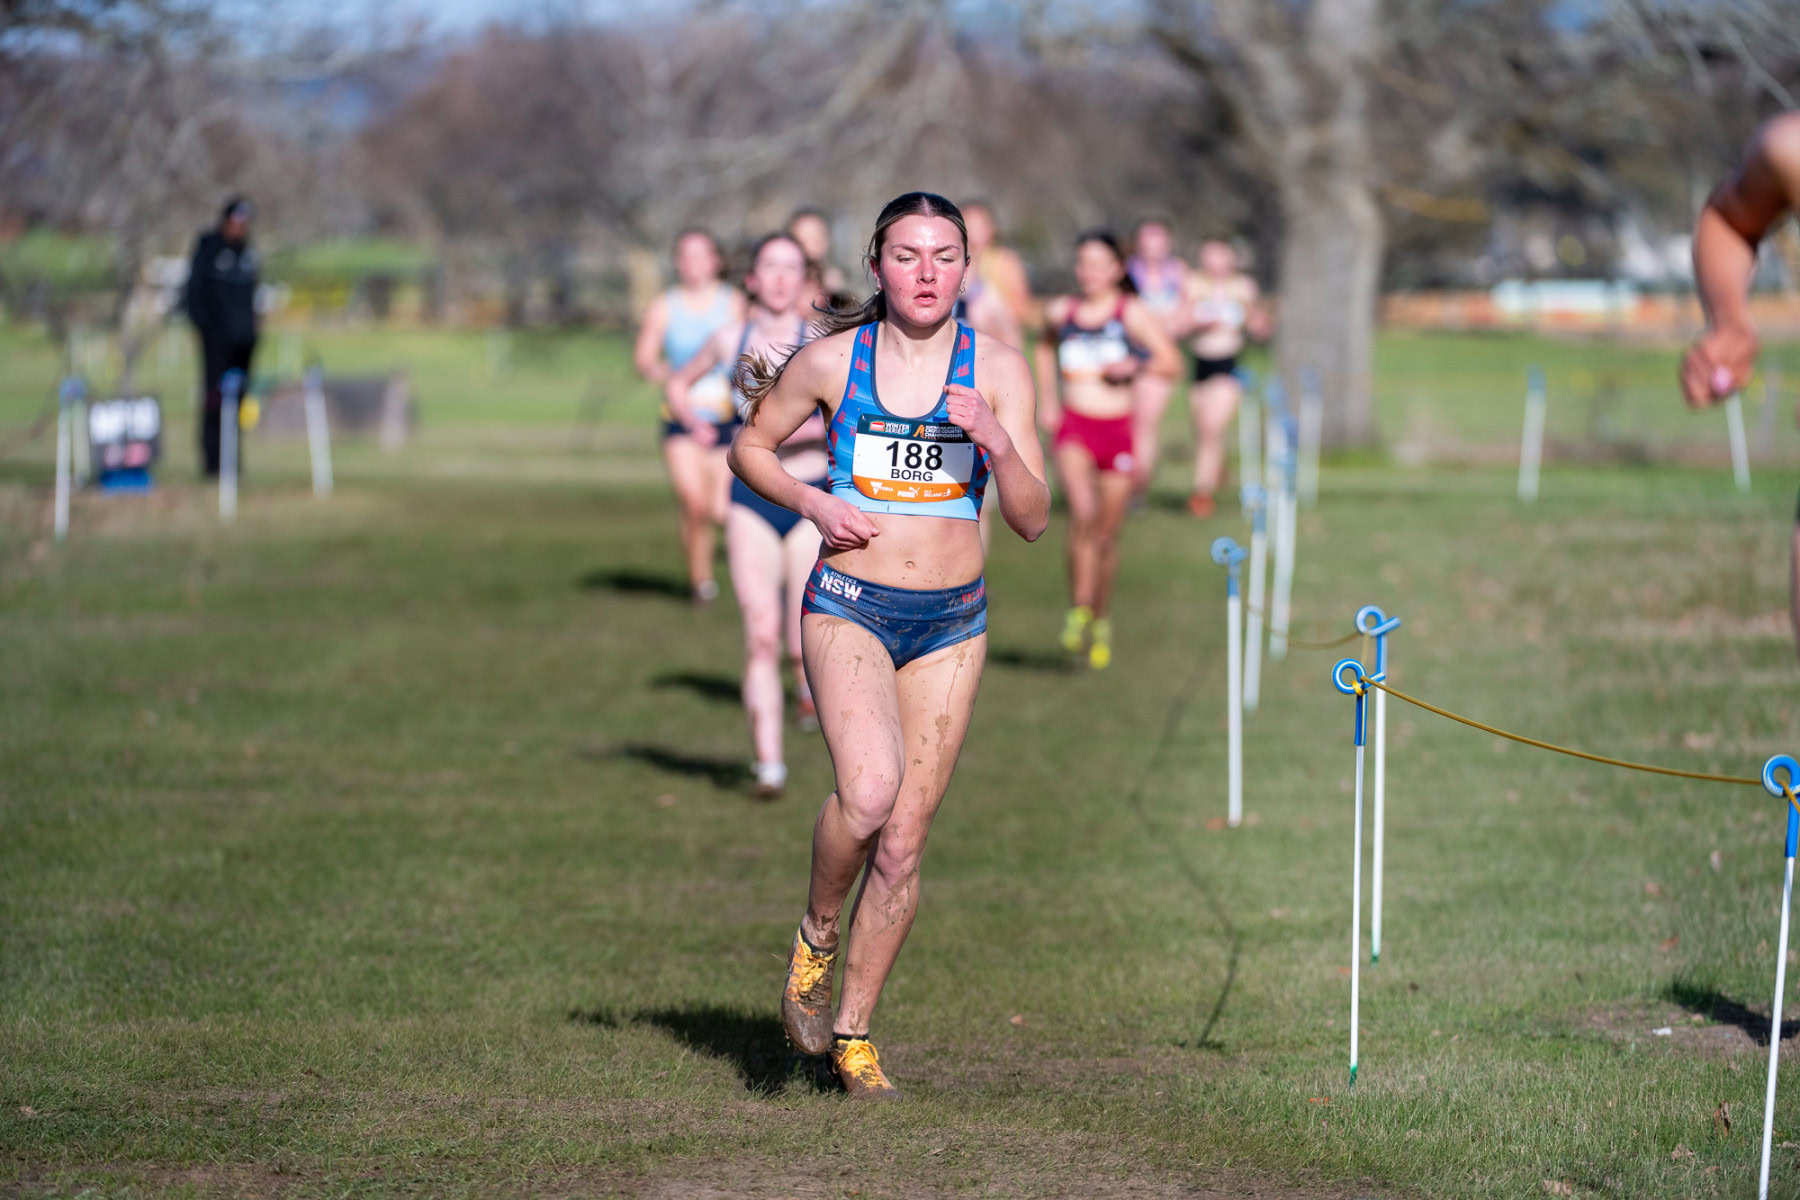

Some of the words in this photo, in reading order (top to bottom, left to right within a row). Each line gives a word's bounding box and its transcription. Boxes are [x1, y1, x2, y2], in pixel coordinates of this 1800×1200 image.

[886, 440, 943, 471] 188
[890, 468, 933, 482] BORG
[820, 572, 863, 602] NSW
[830, 571, 858, 585] ATHLETICS
